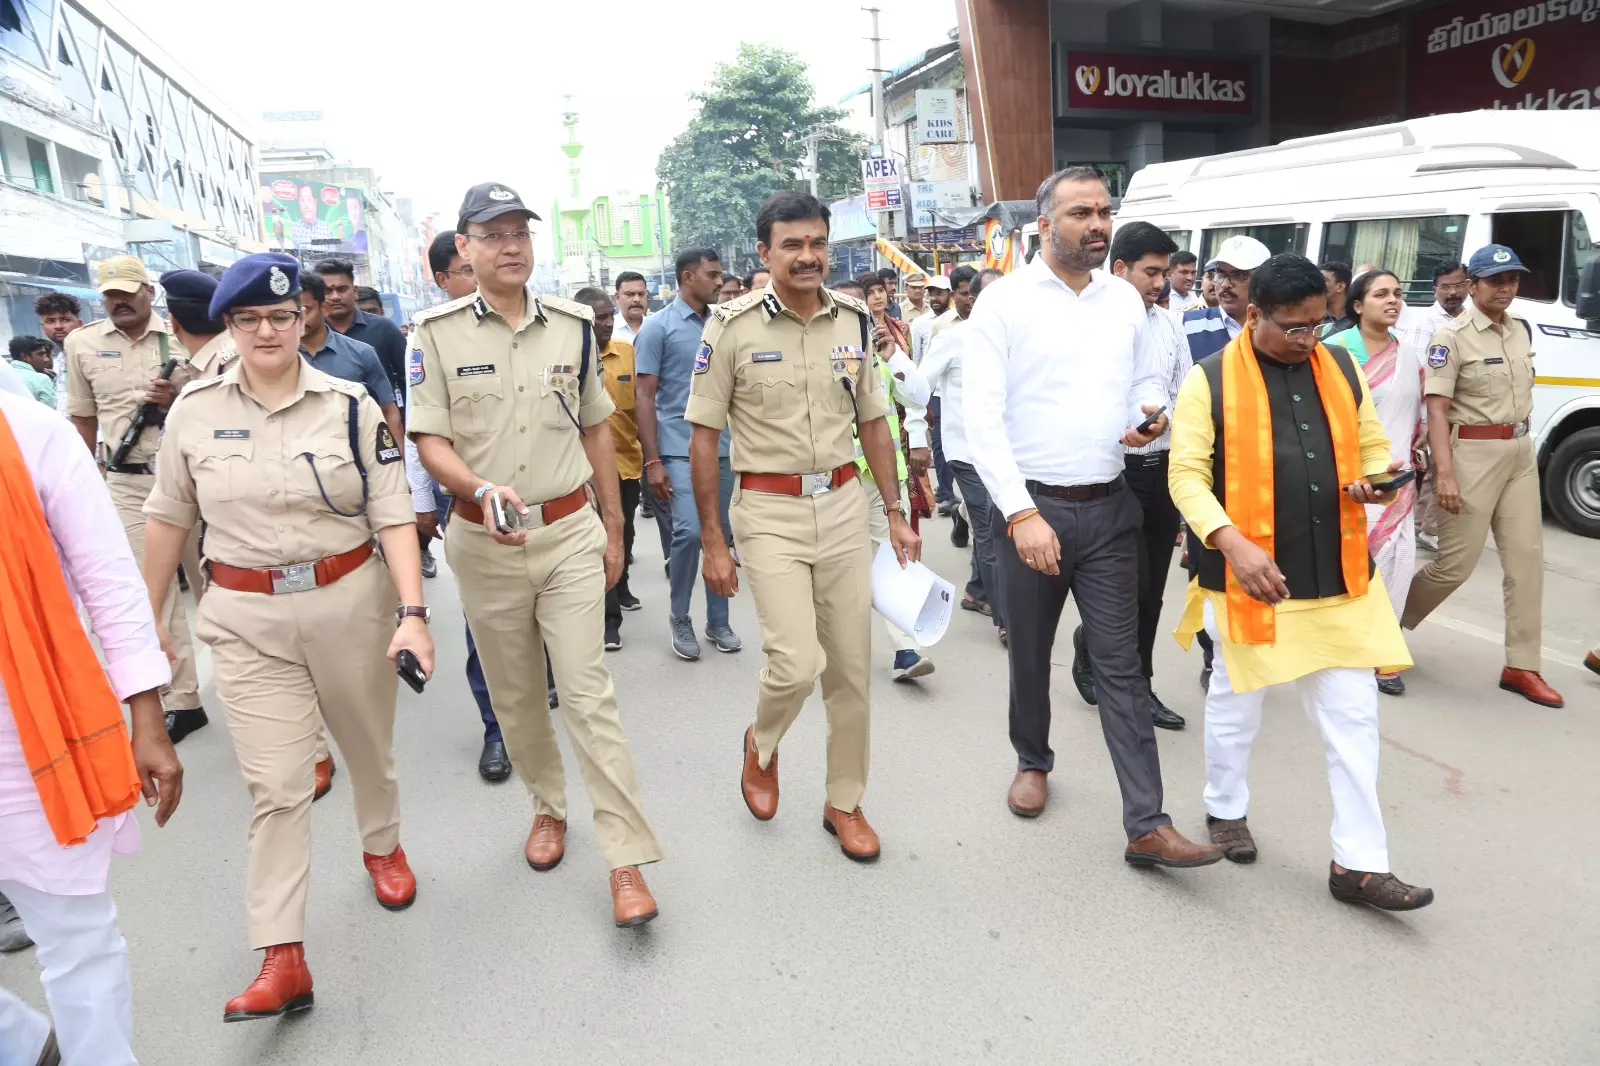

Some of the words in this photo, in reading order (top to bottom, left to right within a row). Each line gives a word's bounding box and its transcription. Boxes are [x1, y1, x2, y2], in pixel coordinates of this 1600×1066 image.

[1104, 66, 1246, 102] Joyalukkas
[927, 119, 953, 128] KIDS
[926, 129, 954, 138] CARE
[865, 158, 897, 178] APEX
[917, 184, 933, 193] THE
[916, 199, 937, 208] KIDS
